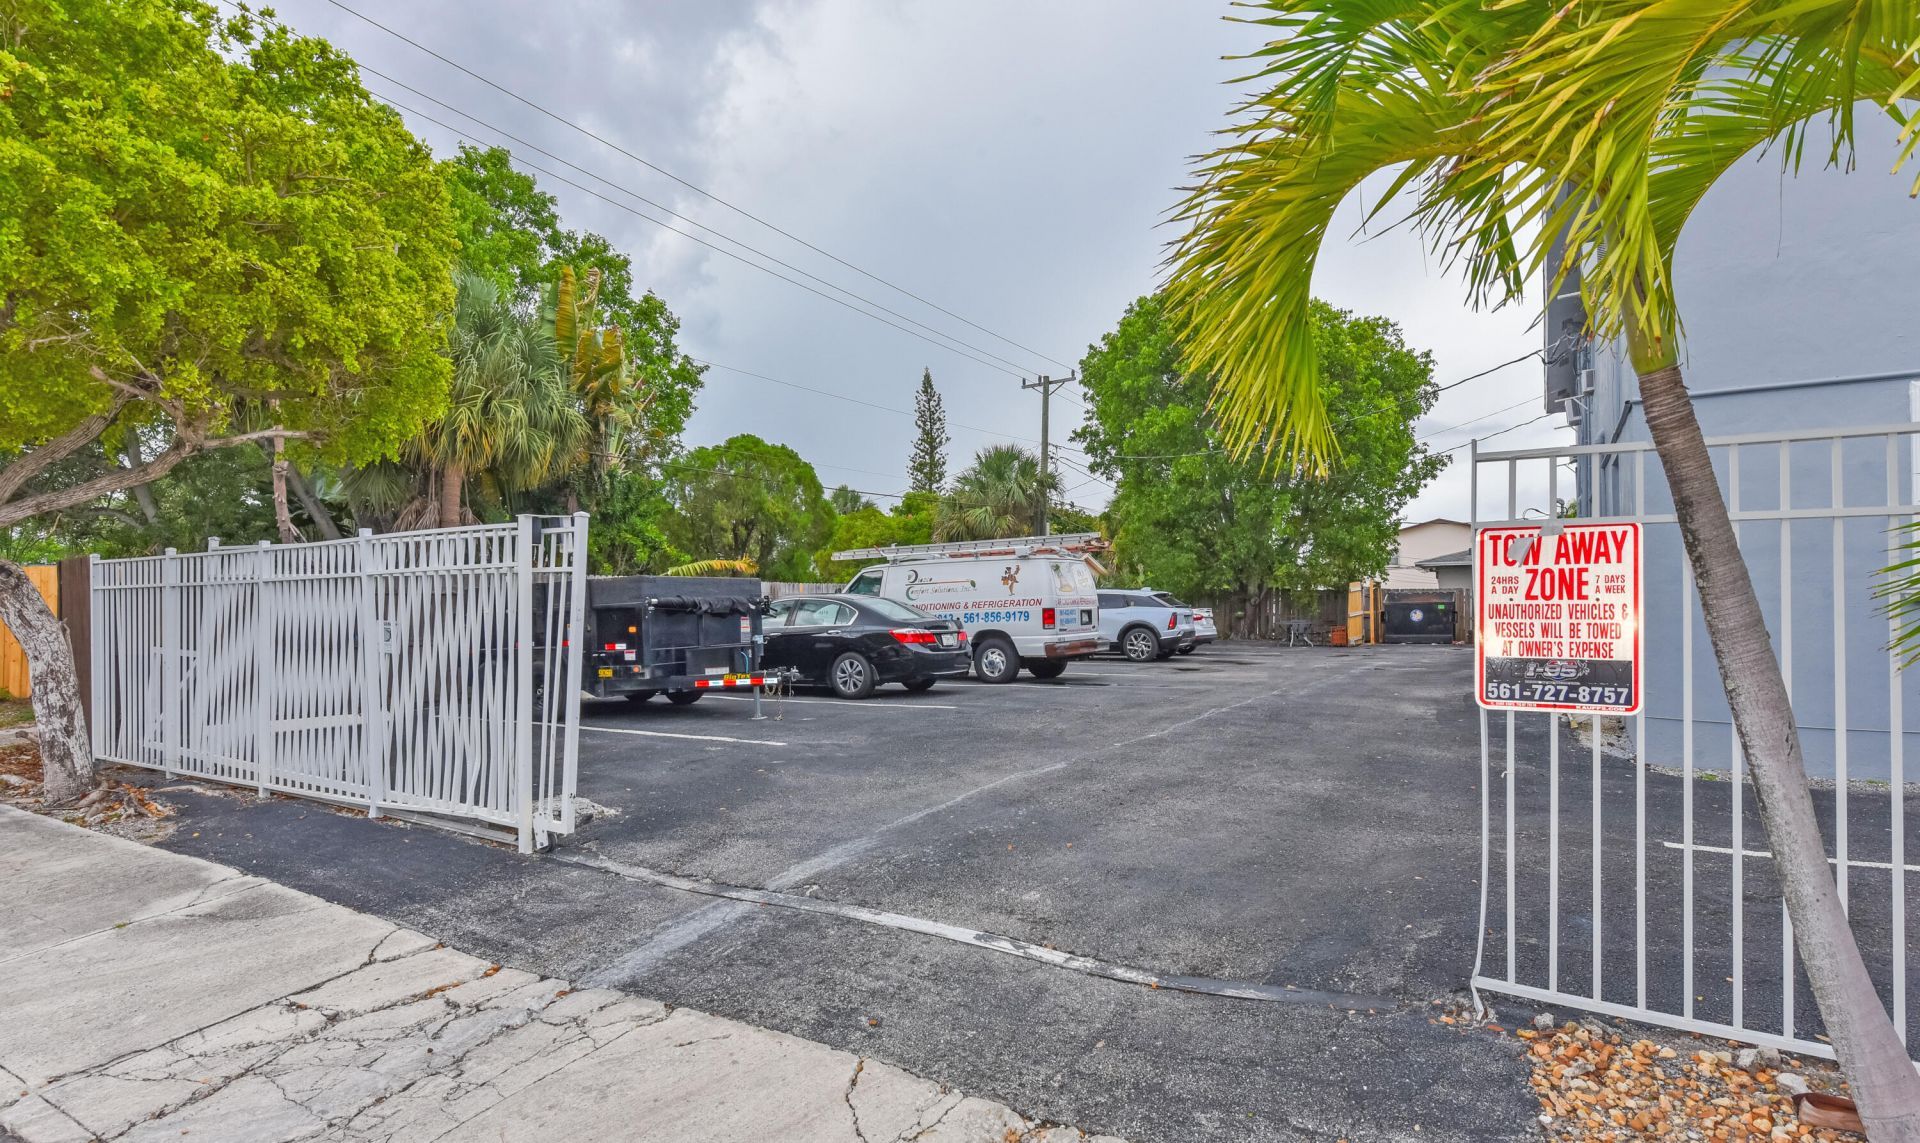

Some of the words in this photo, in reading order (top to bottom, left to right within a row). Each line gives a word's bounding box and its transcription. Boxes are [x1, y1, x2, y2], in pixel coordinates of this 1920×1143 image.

[1489, 534, 1542, 566] TOW
[1555, 530, 1627, 564] AWAY
[1491, 576, 1519, 584] 24HRS
[1525, 568, 1588, 600] ZONE
[1604, 575, 1625, 583] DAYS
[1492, 586, 1497, 594] A
[1595, 586, 1600, 594] A
[911, 601, 961, 611] NDITIONING
[963, 601, 969, 610] &
[971, 598, 1043, 608] REFRIGERATION
[964, 611, 1030, 624] 561-856-9179
[1489, 604, 1562, 620] UNAUTHORIZED
[1568, 604, 1615, 620] VEHICLES
[1622, 605, 1628, 620] &
[1495, 622, 1534, 638] VESSELS
[1541, 623, 1563, 639] WILL
[1569, 623, 1581, 639] BE
[1587, 623, 1621, 639] TOWED
[1502, 641, 1512, 656] AT
[1519, 641, 1563, 657] OWNER'S
[1569, 642, 1614, 658] EXPENSE
[1488, 683, 1629, 704] 561-727-8757
